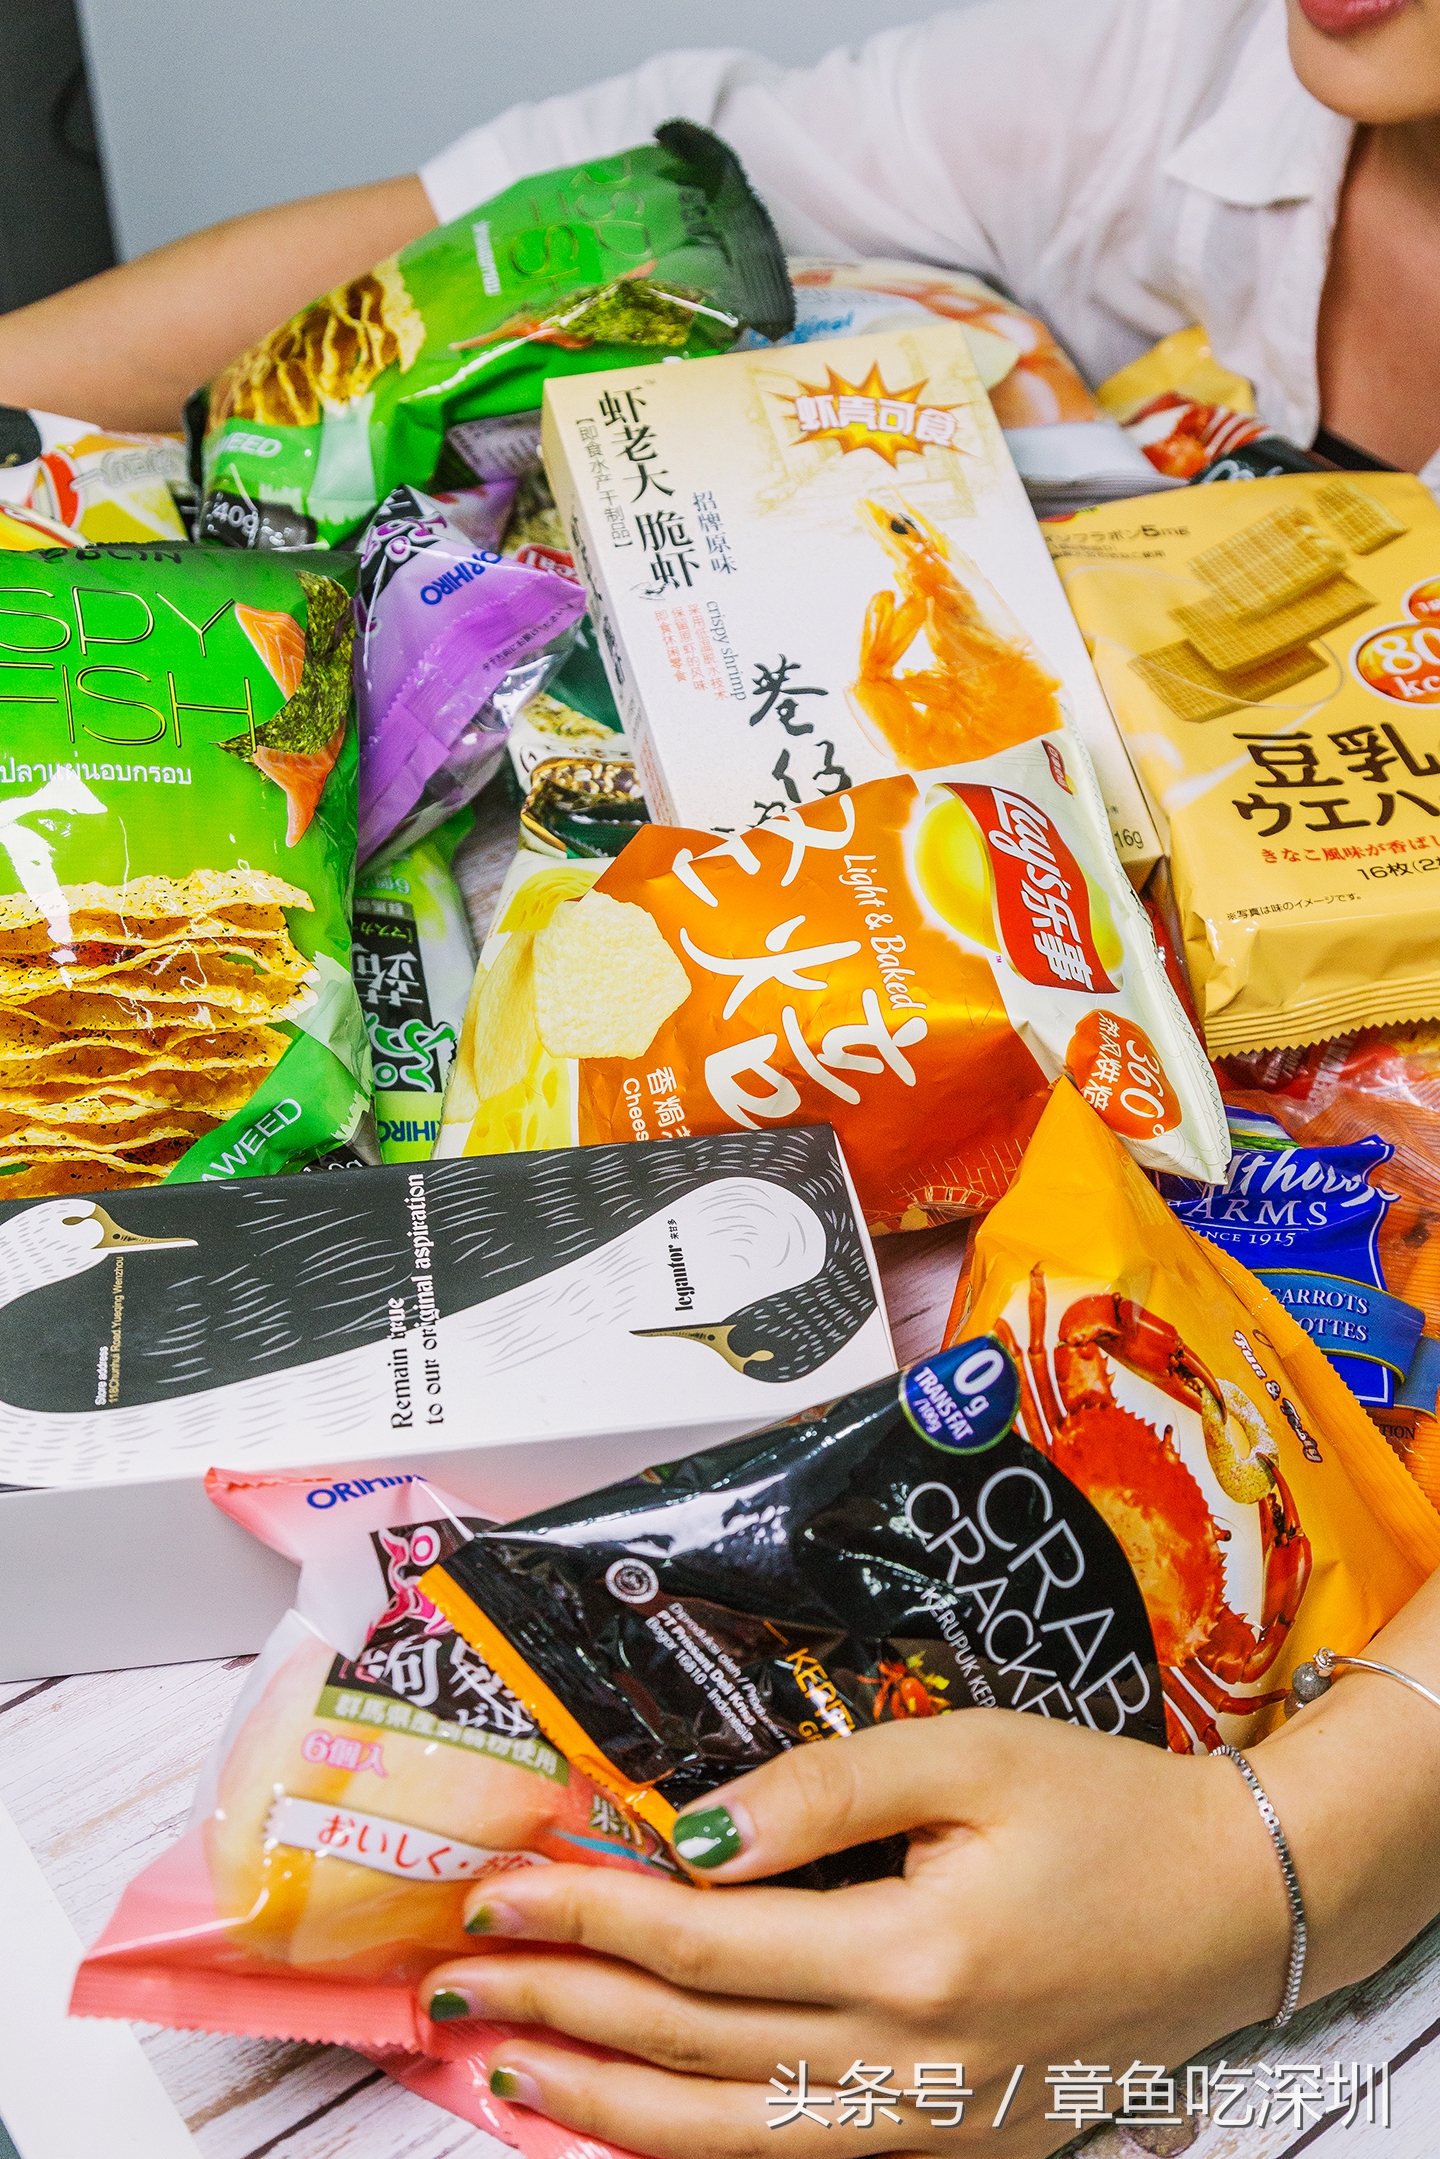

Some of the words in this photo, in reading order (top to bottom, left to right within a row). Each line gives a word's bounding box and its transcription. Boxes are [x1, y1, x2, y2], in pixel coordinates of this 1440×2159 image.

[795, 393, 957, 447] 虾壳可食
[692, 490, 738, 575] 招牌原味
[707, 600, 730, 644] crispy
[721, 646, 747, 701] shrimp
[988, 787, 1074, 898] Lay's
[843, 854, 891, 915] Light
[863, 911, 894, 931] &
[869, 934, 927, 1012] Baked
[1019, 890, 1095, 992] 乐事
[1087, 1011, 1121, 1112] 热风烘焙
[377, 1120, 441, 1143] IHIRO
[404, 1173, 435, 1269] aspiration
[1182, 1199, 1329, 1227] ARMS
[1249, 1232, 1298, 1248] 1915
[113, 1256, 124, 1294] Wenzhou
[411, 1274, 442, 1351] original
[665, 1244, 695, 1312] legantor
[387, 1297, 407, 1340] true
[94, 1381, 107, 1406] Store
[97, 1345, 109, 1380] address
[388, 1347, 414, 1430] Remain
[424, 1358, 442, 1396] our
[1233, 1330, 1268, 1380] Fun
[1265, 1380, 1281, 1400] &
[1280, 1397, 1323, 1463] Tasty
[425, 1402, 445, 1426] to
[913, 1398, 942, 1434] /100g
[914, 1366, 958, 1418] TRANS
[944, 1410, 974, 1441] FAT
[904, 1481, 1080, 1727] CRACKE
[977, 1465, 1151, 1736] CRAB
[645, 1616, 678, 1652] Bogor
[706, 1687, 755, 1744] Indonesia
[656, 1609, 678, 1628] PT
[711, 1671, 736, 1698] Deli
[728, 1689, 758, 1727] Krisp
[920, 1587, 980, 1679] KERUPUK
[967, 1674, 999, 1710] KEP
[300, 1729, 389, 1779] 6個入
